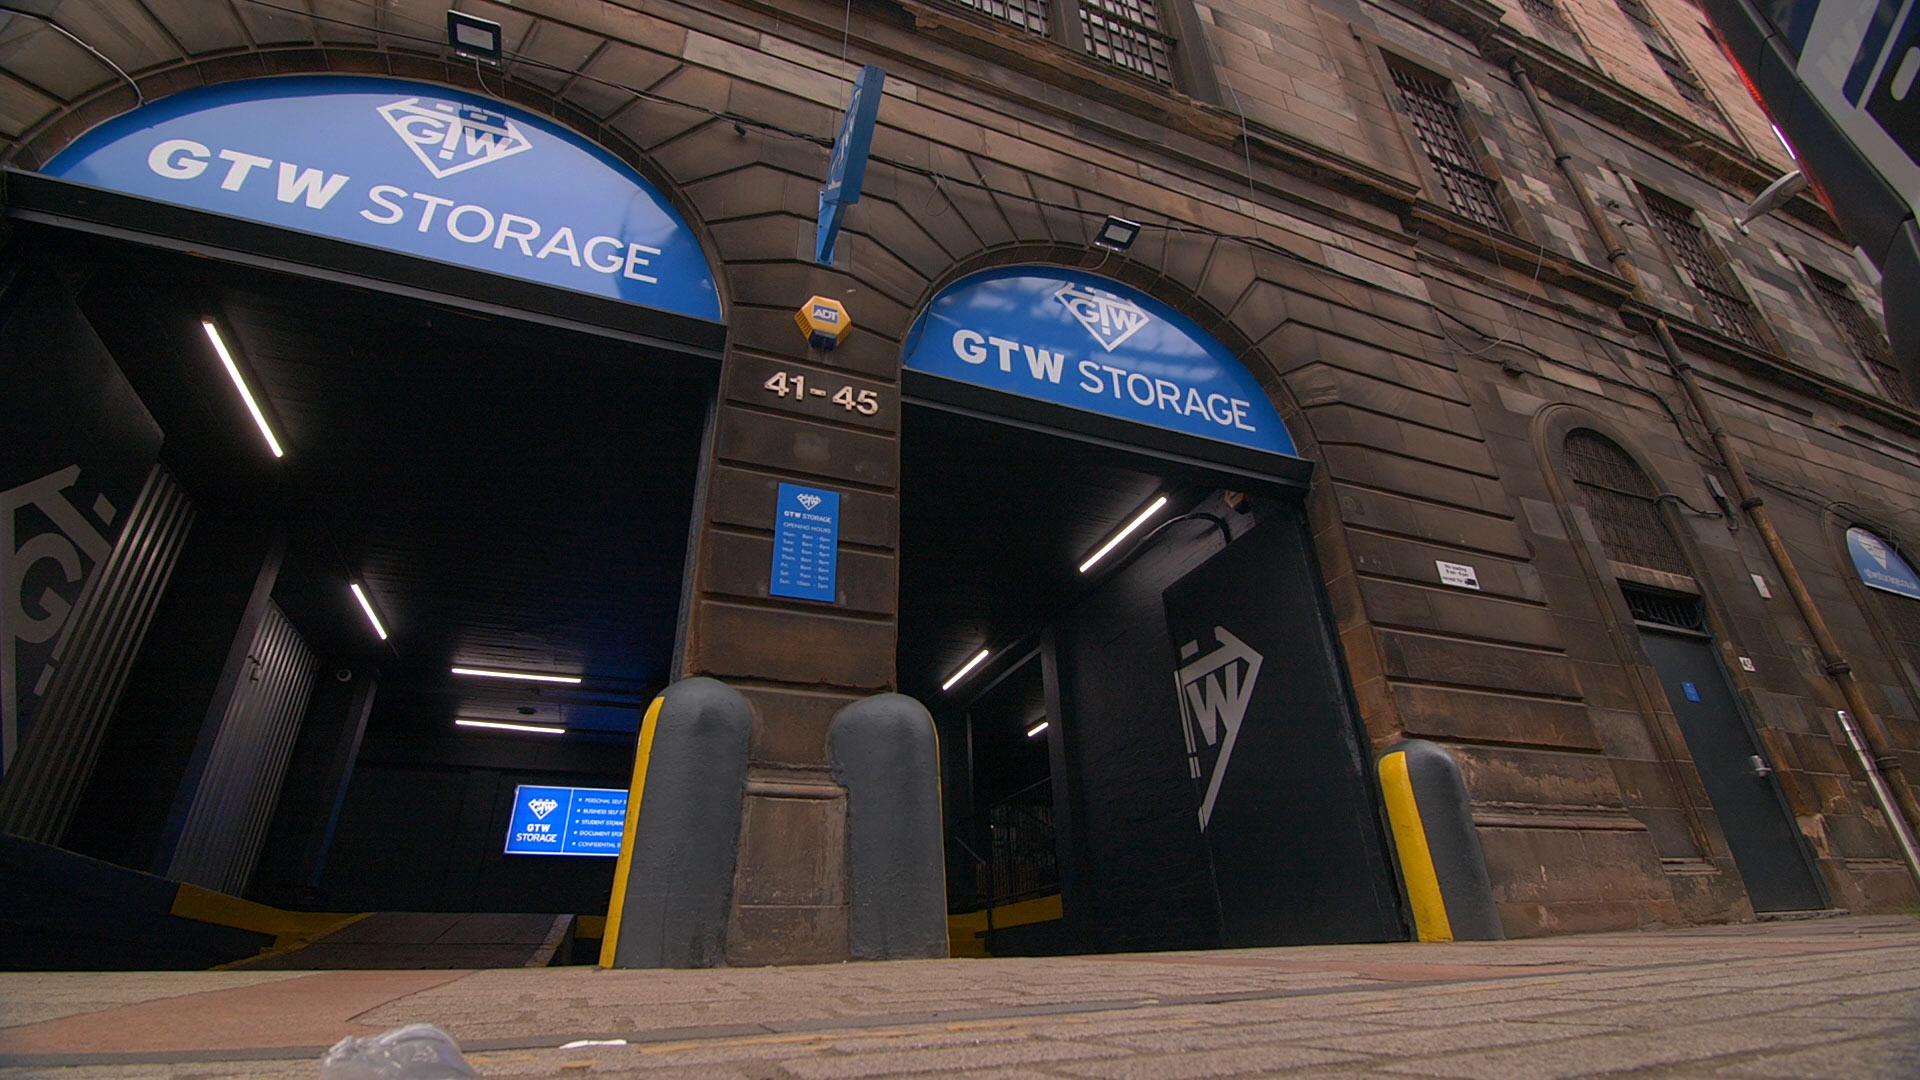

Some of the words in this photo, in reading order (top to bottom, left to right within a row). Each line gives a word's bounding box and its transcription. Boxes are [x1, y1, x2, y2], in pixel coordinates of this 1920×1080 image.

[147, 138, 350, 210] GTW
[359, 184, 662, 285] STORAGE
[814, 308, 839, 321] ADT
[952, 329, 1065, 385] GTW
[1079, 360, 1257, 433] STORAGE
[784, 510, 801, 519] GTW
[802, 513, 832, 523] STORAGE
[783, 521, 810, 530] OPENING
[811, 526, 831, 534] HOURS
[527, 823, 551, 832] GTW
[516, 832, 558, 843] STORAGE
